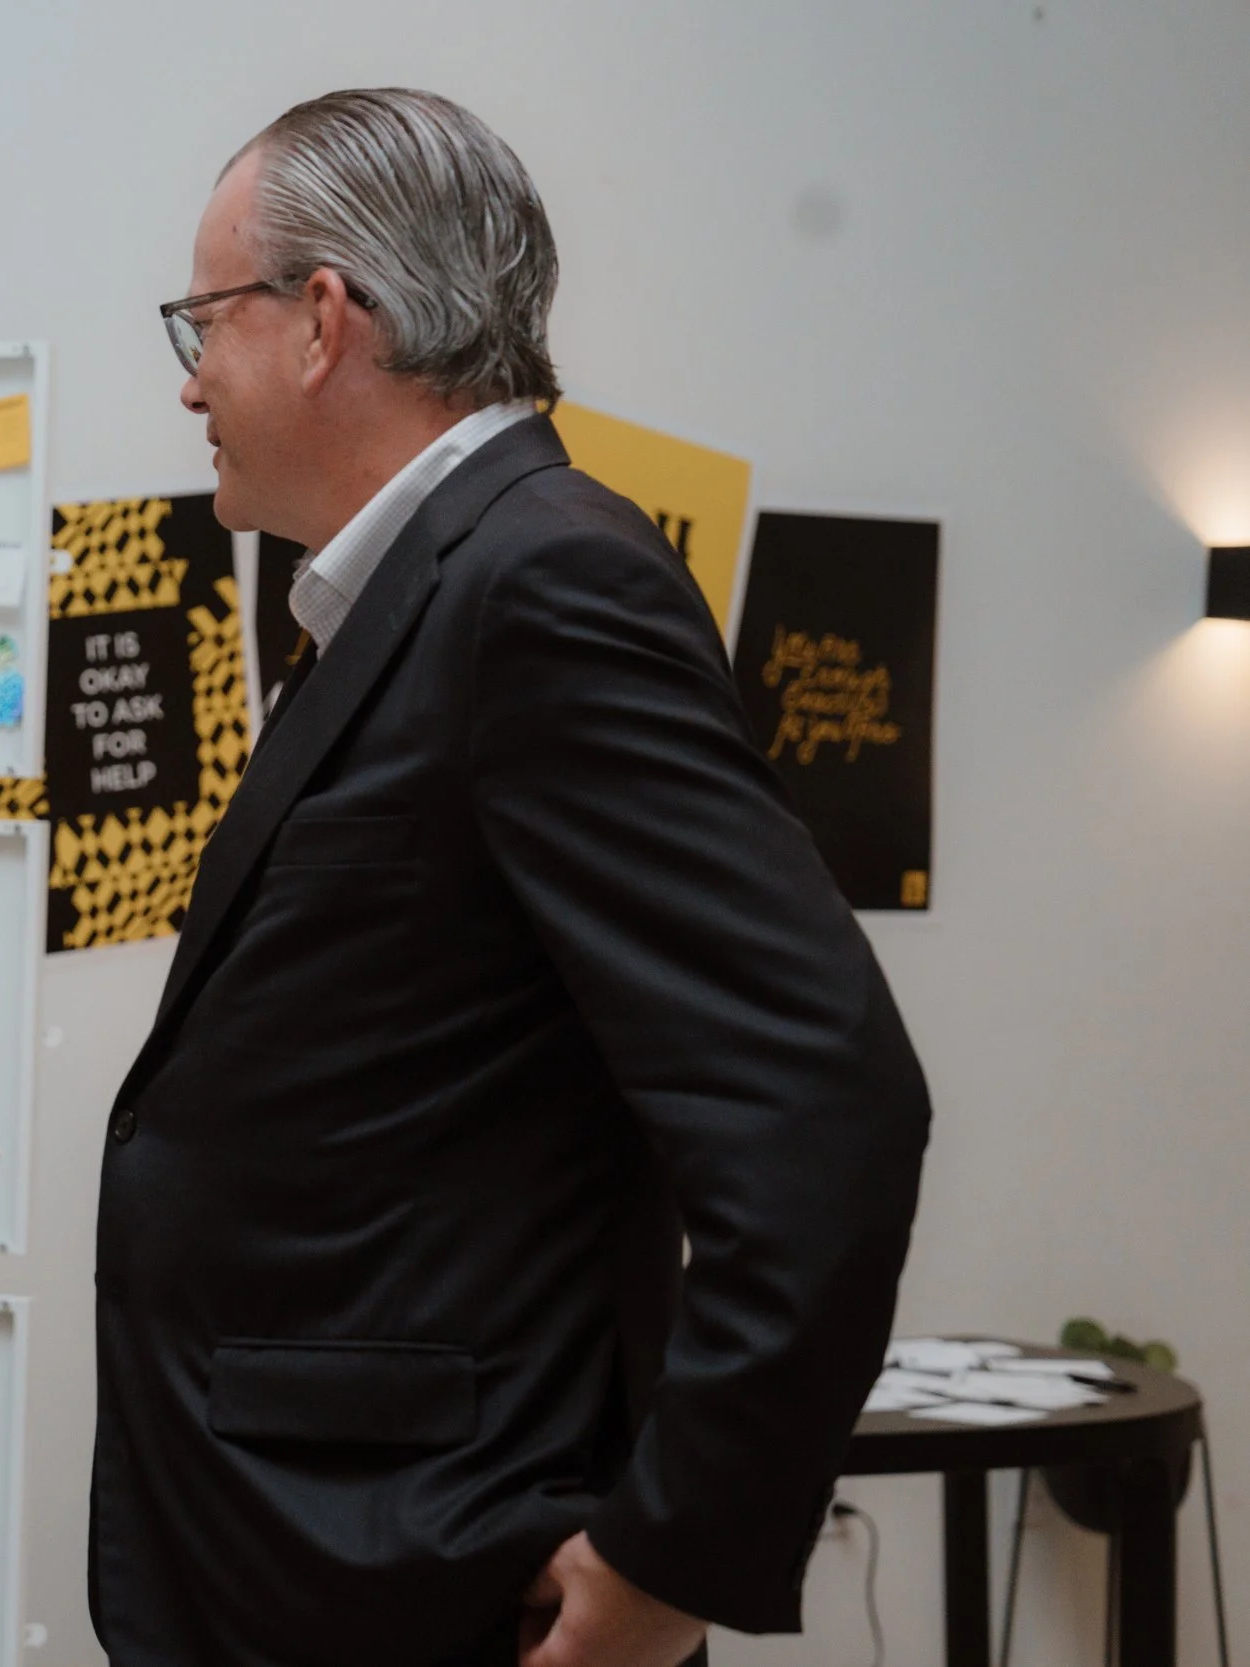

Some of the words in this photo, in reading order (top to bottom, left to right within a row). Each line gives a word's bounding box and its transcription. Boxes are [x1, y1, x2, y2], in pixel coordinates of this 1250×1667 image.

[85, 634, 110, 663] IT
[115, 631, 140, 659] IS
[79, 661, 150, 696] OKAY
[70, 700, 108, 730] TO
[111, 693, 165, 724] ASK
[92, 728, 148, 760] FOR
[90, 760, 157, 794] HELP
